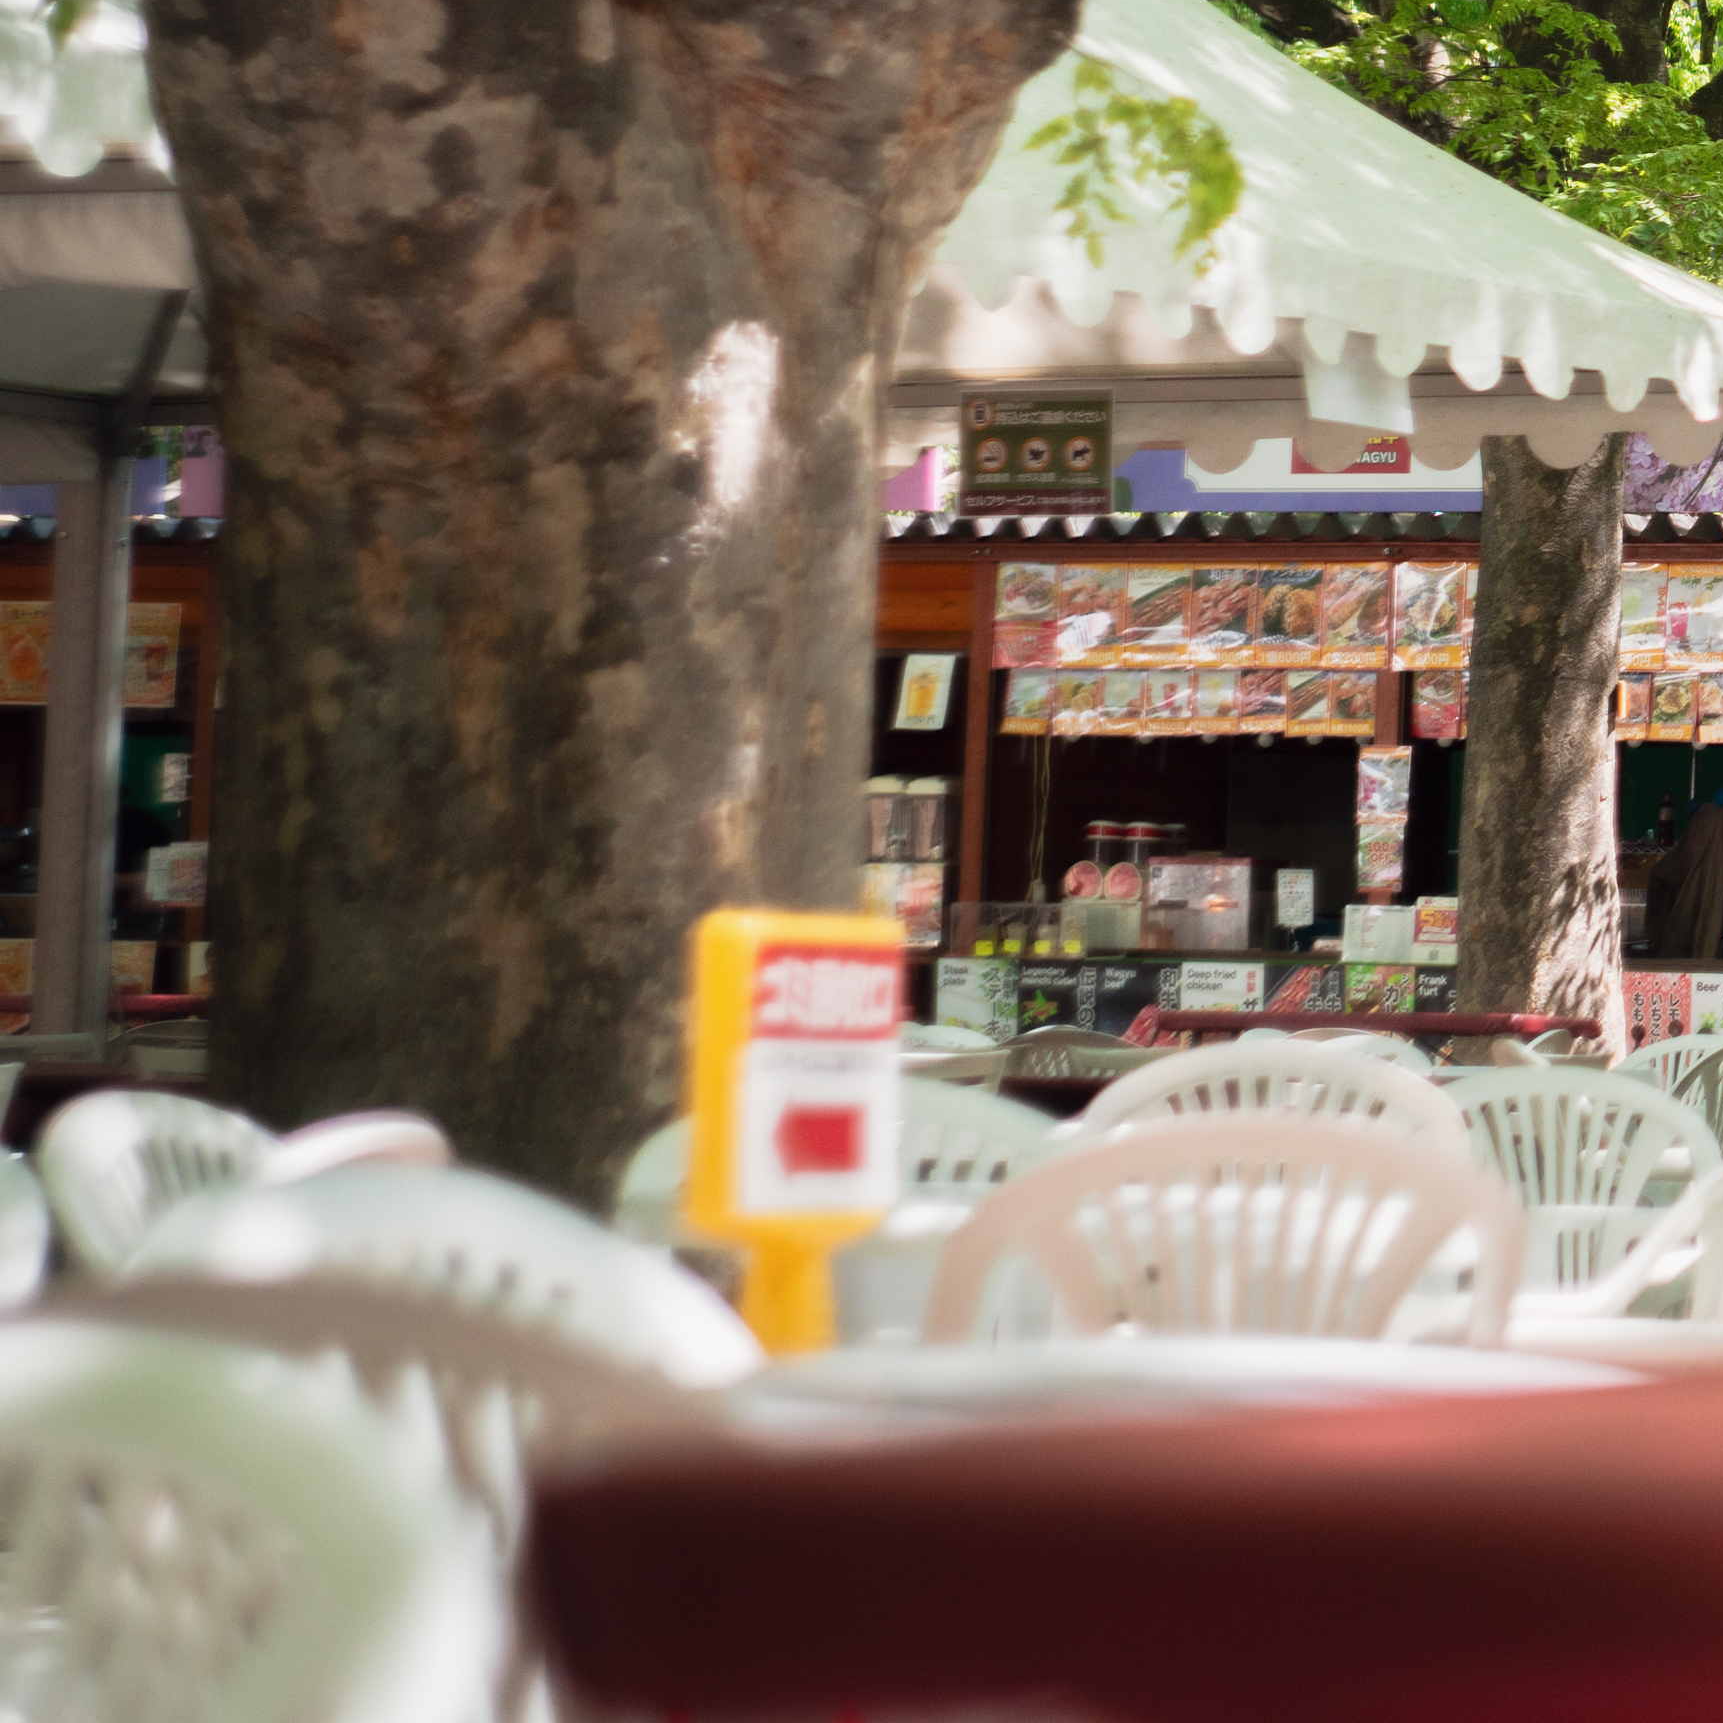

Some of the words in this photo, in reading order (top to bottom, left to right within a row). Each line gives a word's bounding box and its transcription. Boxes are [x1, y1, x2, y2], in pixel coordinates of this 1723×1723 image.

[1356, 450, 1398, 464] AGYU
[966, 495, 1036, 507] セルフサービス
[943, 965, 970, 976] Steak
[1022, 966, 1066, 977] Legendary
[1105, 966, 1137, 979] Wagyu
[1187, 968, 1210, 981] Deep
[1211, 968, 1237, 980] fried
[942, 977, 967, 987] plate
[1105, 978, 1126, 989] beef
[1187, 980, 1224, 990] chicken
[1419, 974, 1447, 985] Frank
[1418, 985, 1439, 996] furt
[1696, 981, 1720, 993] Beer
